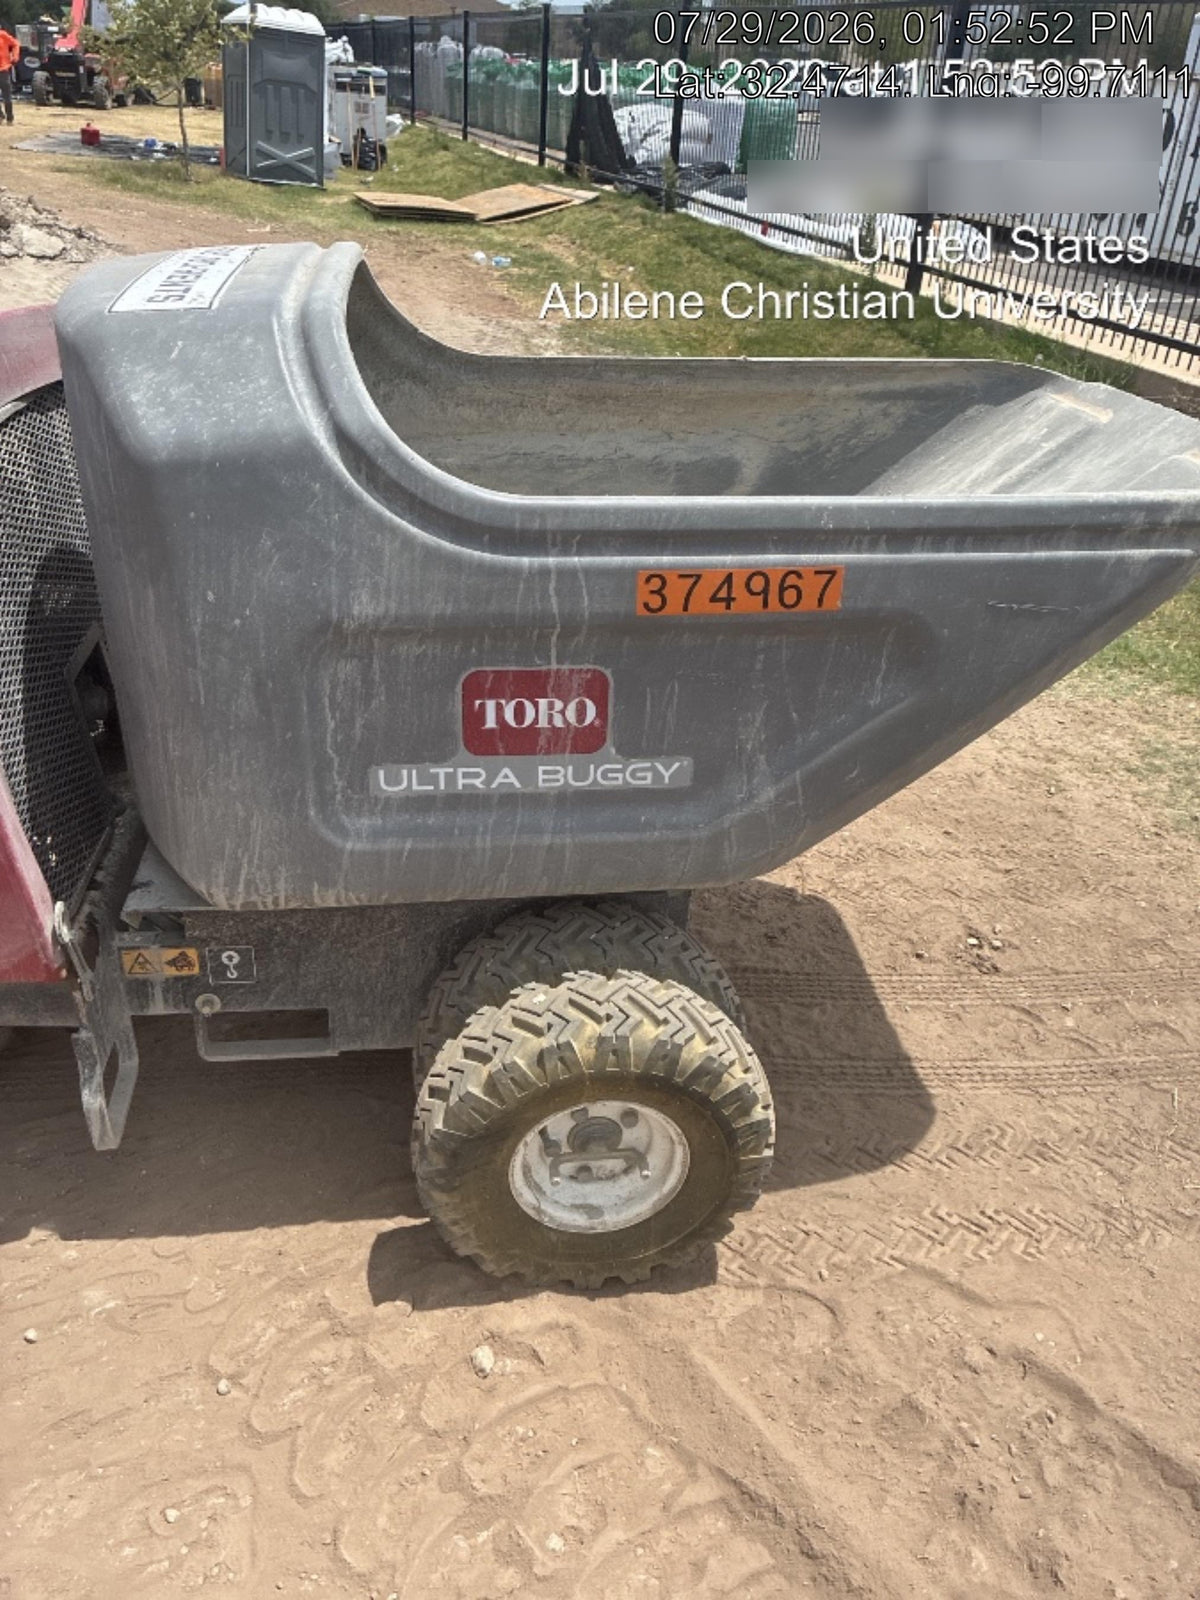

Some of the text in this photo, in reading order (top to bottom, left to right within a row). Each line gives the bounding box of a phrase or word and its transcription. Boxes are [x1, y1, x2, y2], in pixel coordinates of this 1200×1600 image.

[642, 568, 838, 614] 374967
[474, 696, 597, 730] TORO
[378, 761, 681, 792] ULTRA BUGGY
